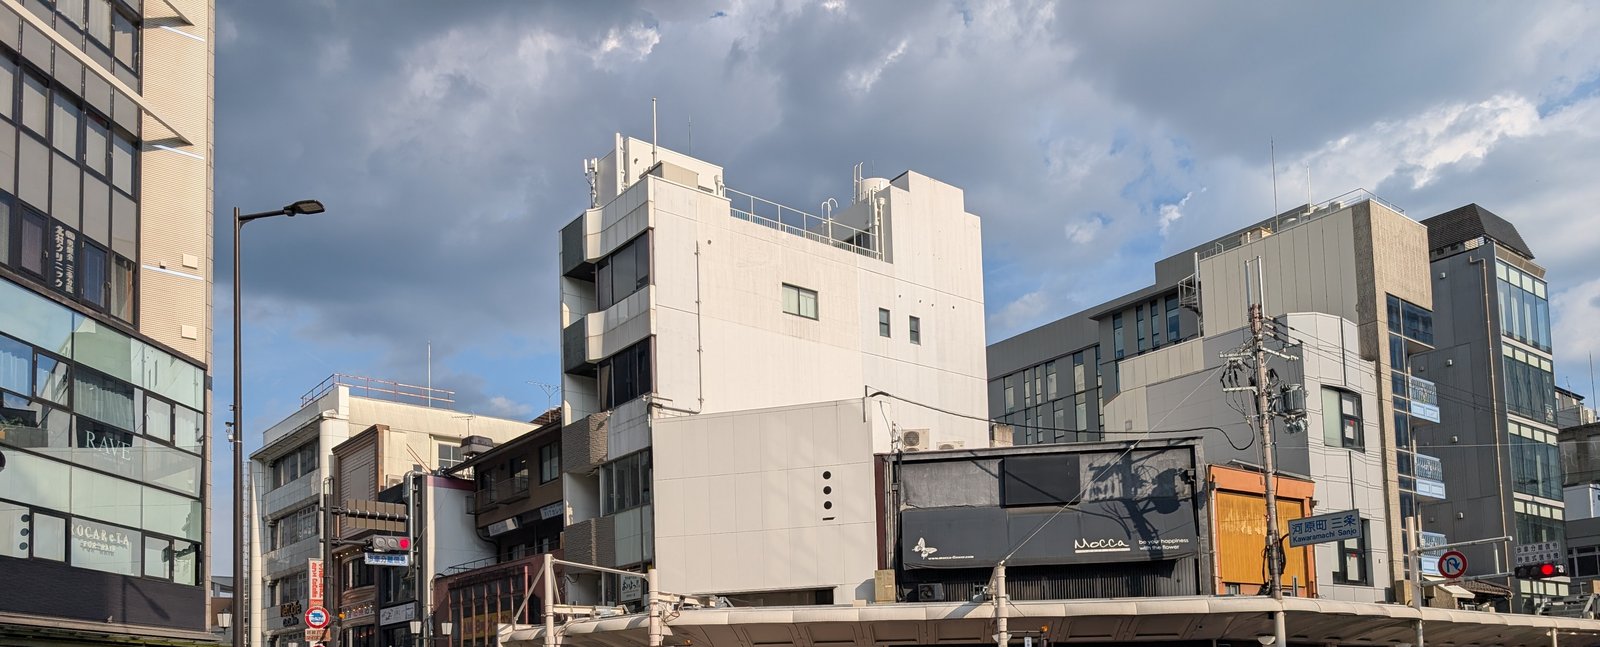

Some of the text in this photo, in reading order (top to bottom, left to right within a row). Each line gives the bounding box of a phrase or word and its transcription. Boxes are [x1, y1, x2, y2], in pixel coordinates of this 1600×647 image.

[85, 430, 130, 461] RAVE
[1291, 514, 1356, 535] 河原町 三条
[1160, 538, 1189, 546] happiness
[1293, 527, 1357, 543] Kawaramachi Sanjo
[1074, 538, 1129, 549] Mocca
